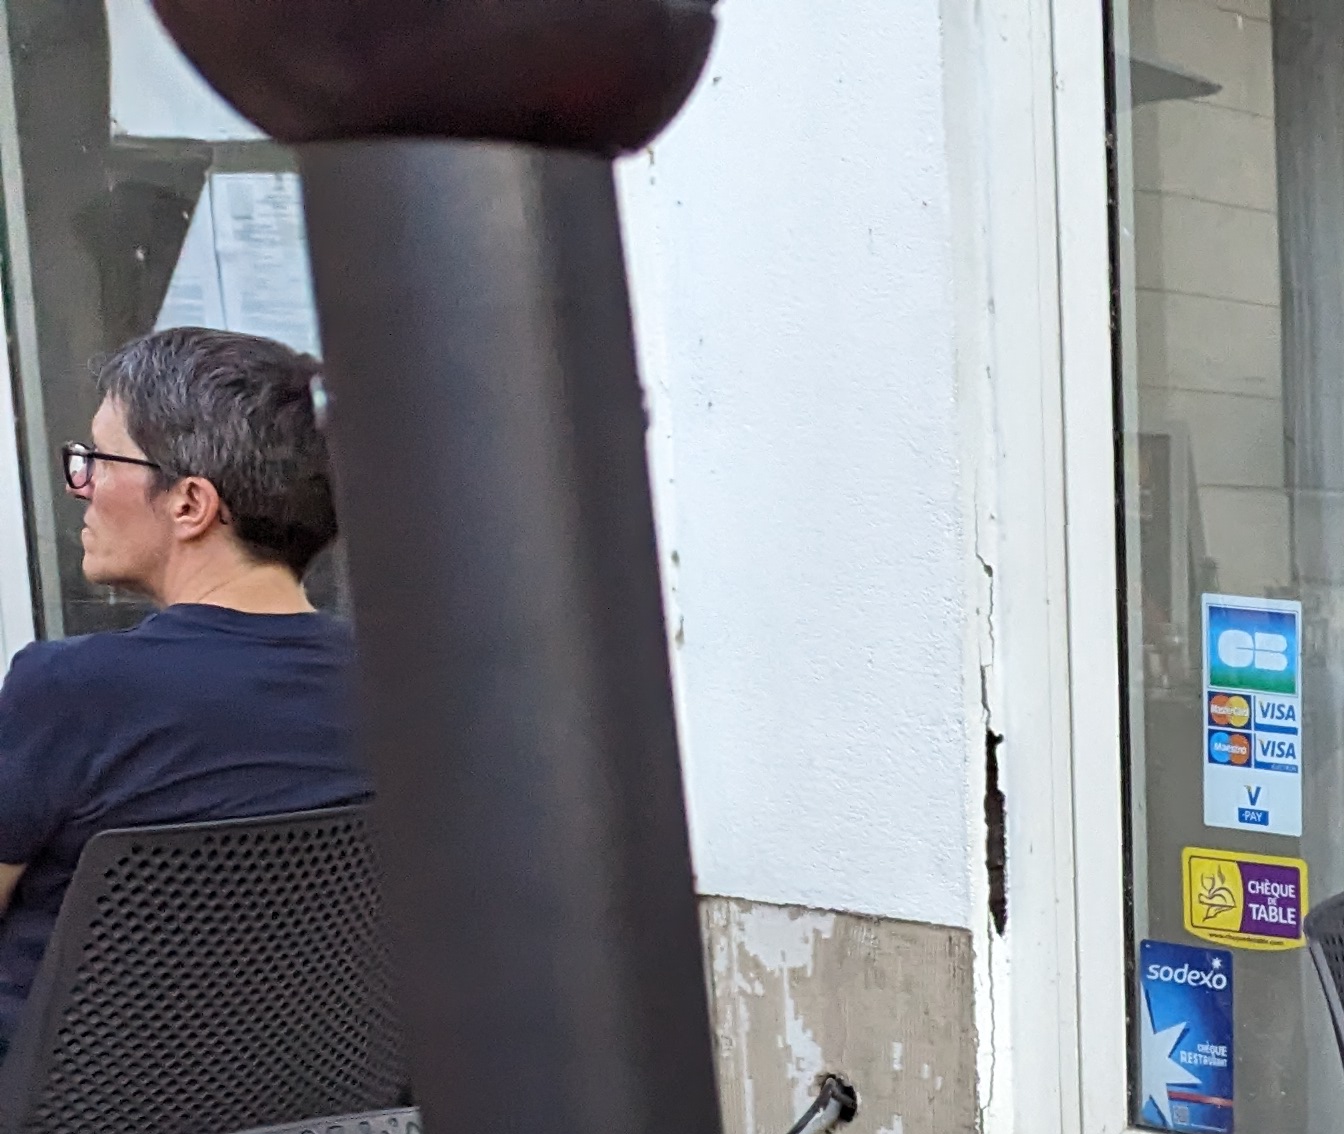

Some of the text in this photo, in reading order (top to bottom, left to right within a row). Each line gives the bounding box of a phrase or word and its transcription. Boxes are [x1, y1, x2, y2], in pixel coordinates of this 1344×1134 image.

[1259, 702, 1297, 722] VISA
[1259, 740, 1297, 760] VISA
[1243, 811, 1263, 823] PAY
[1248, 879, 1297, 899] CHÈQUE
[1248, 904, 1297, 925] TABLE
[1146, 962, 1228, 991] sodexo
[1197, 1041, 1228, 1059] CHÈQUE
